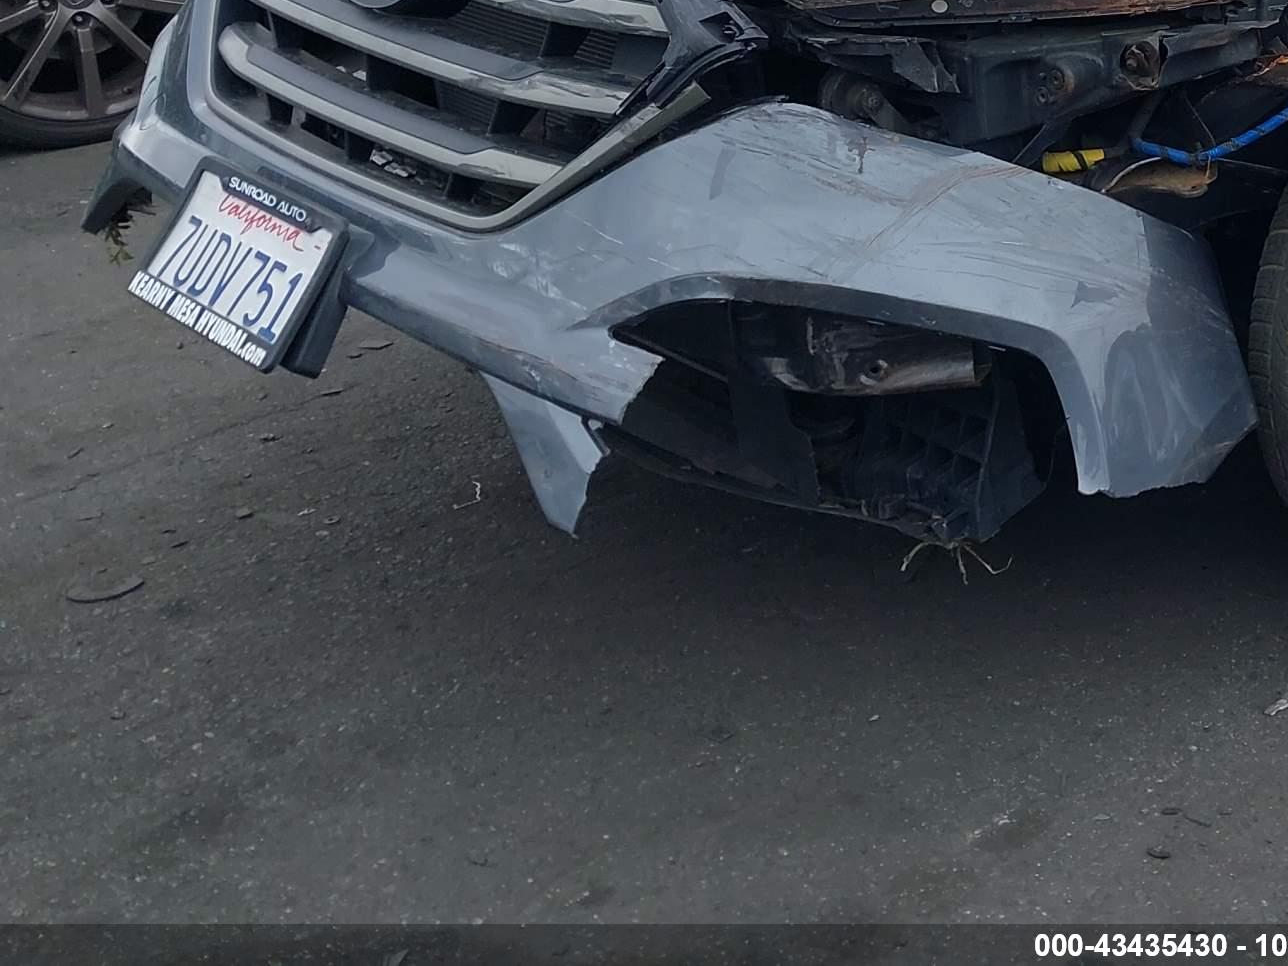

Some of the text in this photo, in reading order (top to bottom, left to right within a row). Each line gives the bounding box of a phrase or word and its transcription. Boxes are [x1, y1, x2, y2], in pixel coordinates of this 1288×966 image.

[218, 194, 304, 252] California
[229, 177, 306, 222] SUNROAD AUTO
[157, 215, 303, 342] 7UDV751
[128, 271, 267, 366] KEARNY MESA HYUNDAI.com
